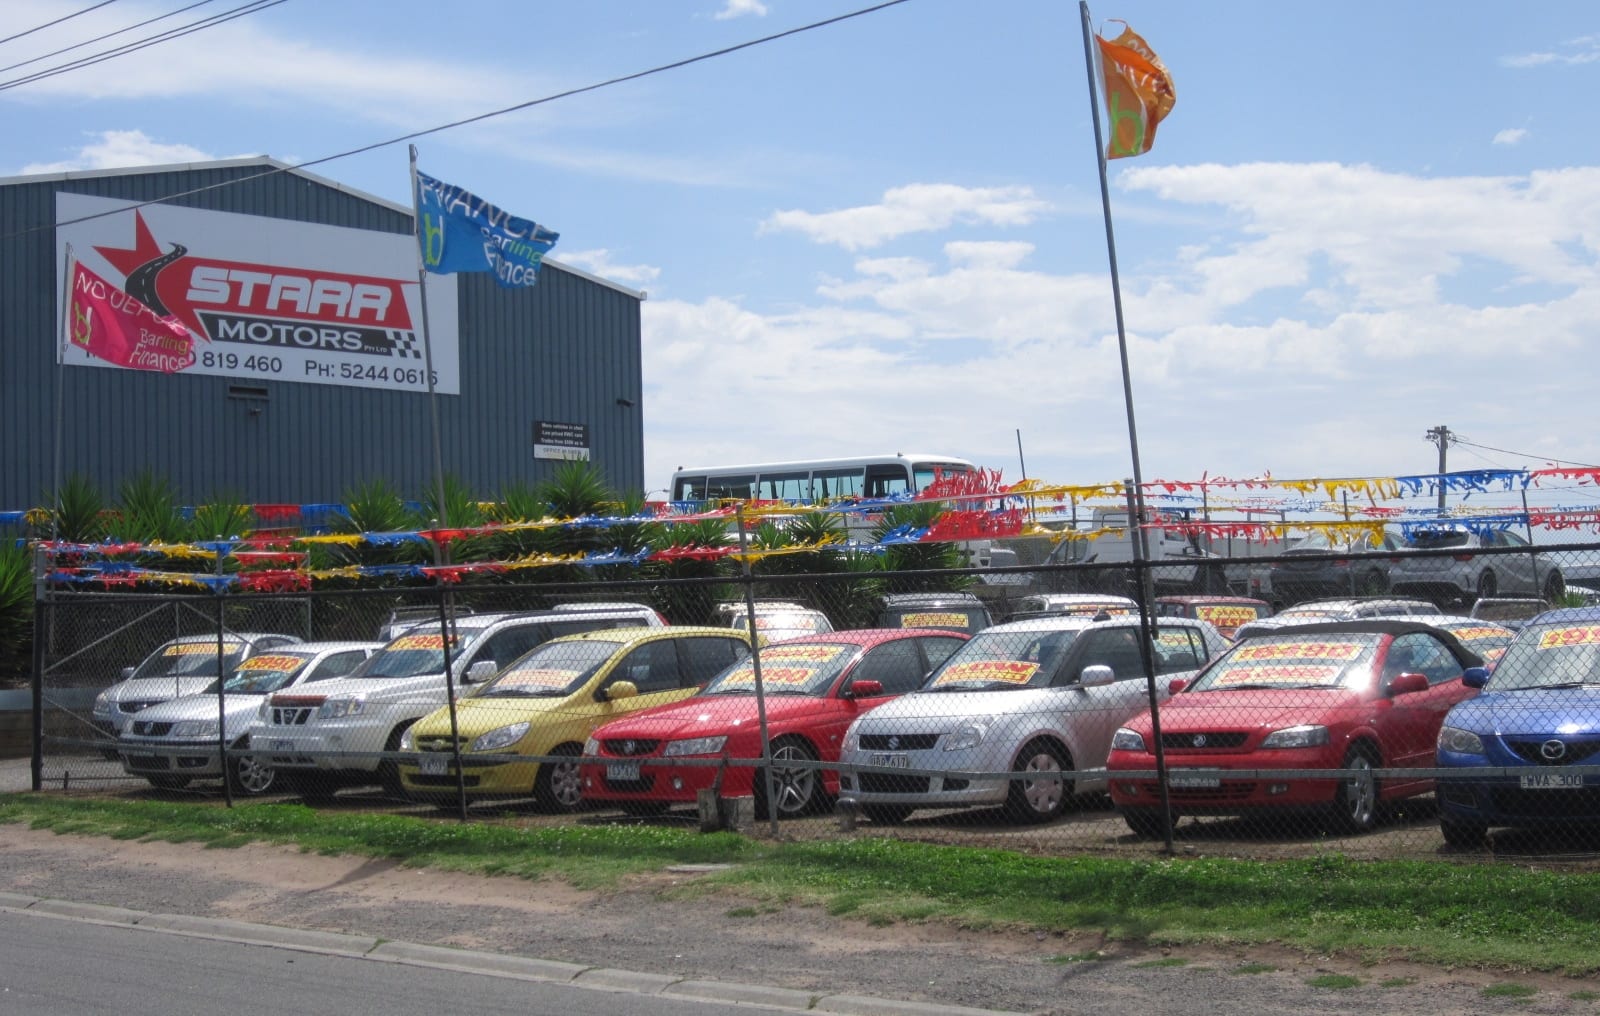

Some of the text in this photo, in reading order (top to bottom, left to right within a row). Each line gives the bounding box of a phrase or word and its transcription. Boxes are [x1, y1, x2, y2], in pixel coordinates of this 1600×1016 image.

[76, 272, 106, 299] NO
[186, 265, 392, 322] STARR
[140, 328, 188, 354] Barling
[217, 319, 363, 351] MOTORS
[129, 343, 188, 371] Finance
[202, 351, 238, 369] 819
[244, 355, 283, 373] 460
[340, 363, 389, 382] 5244
[1558, 773, 1583, 786] 300
